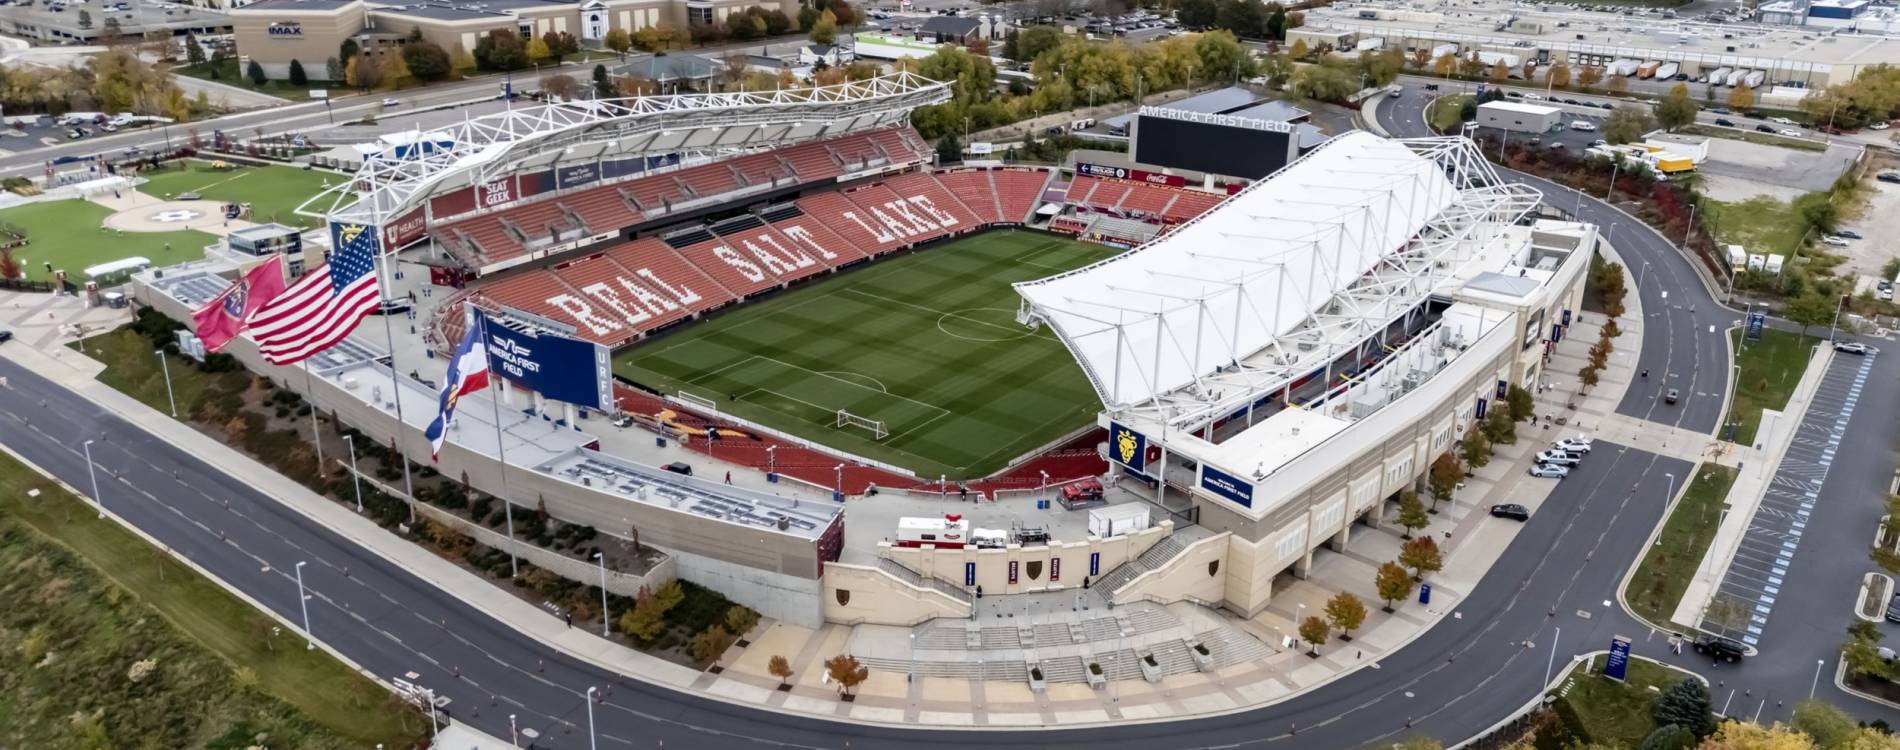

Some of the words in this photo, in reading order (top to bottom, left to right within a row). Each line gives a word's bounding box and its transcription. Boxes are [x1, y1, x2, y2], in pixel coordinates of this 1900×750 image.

[268, 27, 302, 35] IMAX
[1138, 104, 1200, 122] AMERICA
[1204, 113, 1246, 128] FIRST
[1251, 119, 1291, 133] FIELD
[486, 179, 508, 195] SEAT
[486, 190, 510, 205] GEEK
[399, 216, 424, 233] HEALTH
[545, 267, 703, 336] REAL
[712, 225, 838, 283] SALT
[843, 194, 960, 244] LAKE
[489, 343, 517, 365] AMERICA
[517, 356, 541, 373] FIRST
[502, 361, 524, 378] FIELD
[598, 351, 610, 406] URFC
[1204, 476, 1224, 489] AMERICA
